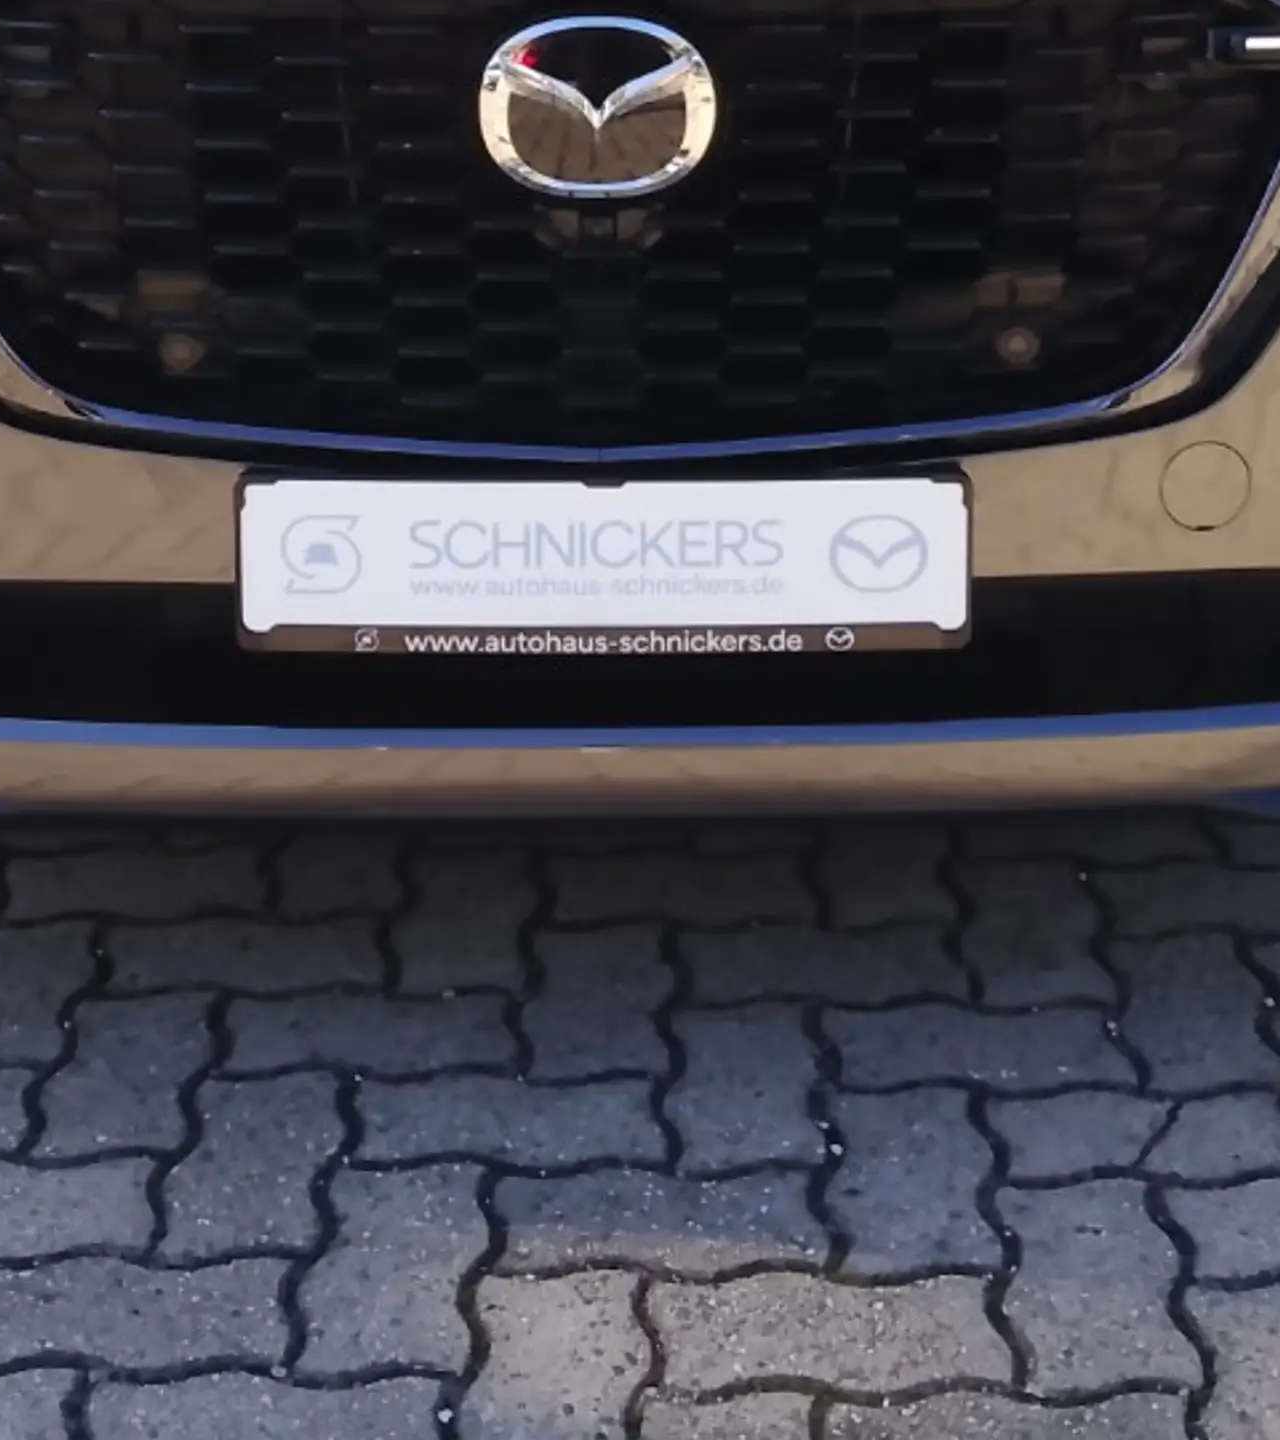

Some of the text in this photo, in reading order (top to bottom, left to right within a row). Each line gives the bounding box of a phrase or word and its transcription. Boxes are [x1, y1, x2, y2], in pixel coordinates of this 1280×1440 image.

[408, 518, 785, 570] SCHNICKERS
[409, 574, 784, 597] www.autohaus-schnickers.de
[404, 629, 803, 654] www.autohaus-schnickers.de
